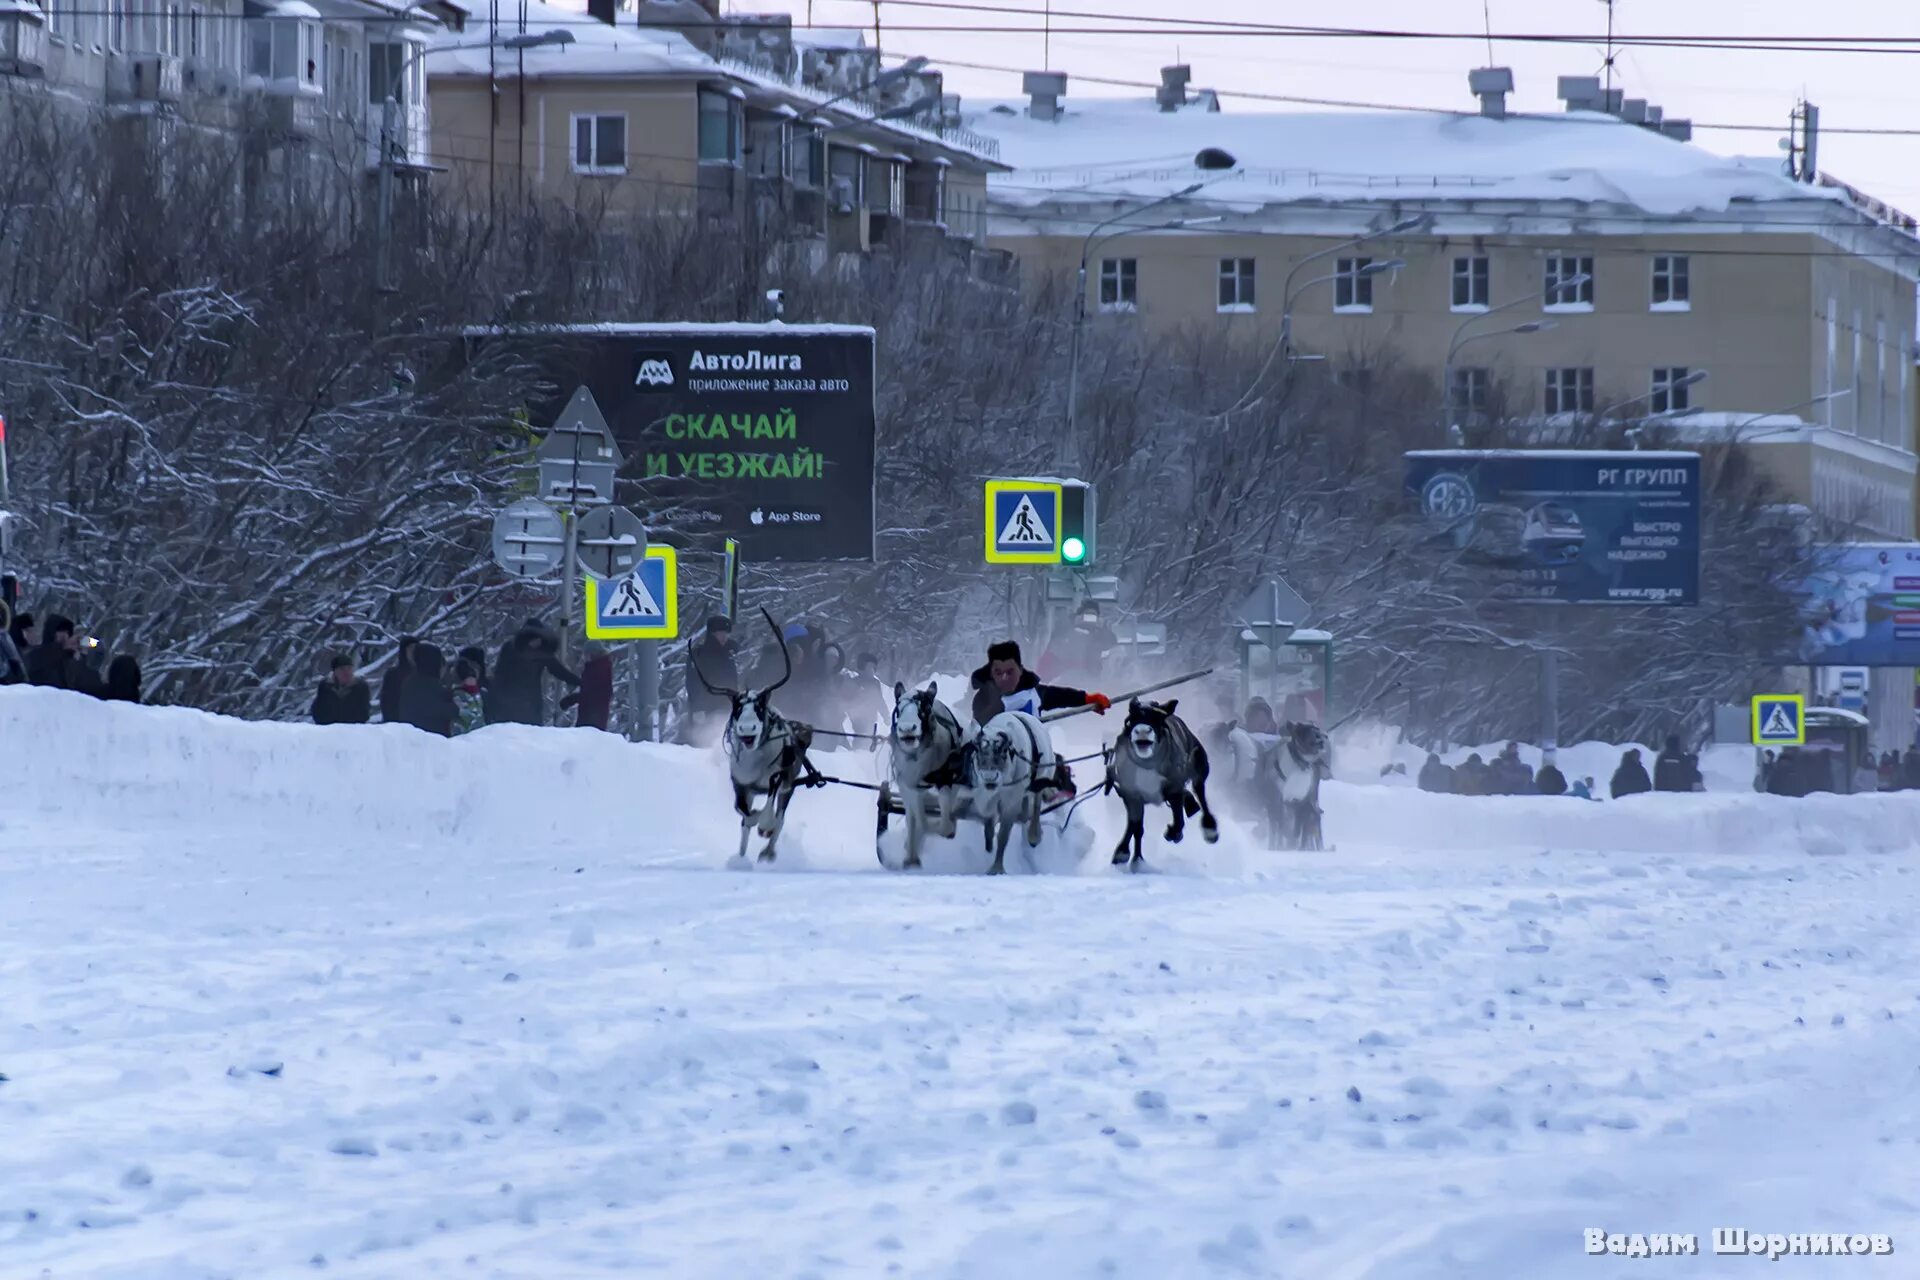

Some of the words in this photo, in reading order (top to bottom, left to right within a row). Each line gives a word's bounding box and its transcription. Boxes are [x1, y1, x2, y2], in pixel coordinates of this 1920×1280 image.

[689, 350, 802, 370] АвтоЛига
[688, 378, 770, 394] приложение
[773, 378, 816, 391] заказа
[820, 378, 850, 391] авто
[665, 407, 797, 440] СКАЧАЙ
[645, 453, 668, 478] И
[677, 447, 823, 479] УЕЗЖАЙ!
[1597, 469, 1619, 484] РГ
[1624, 468, 1687, 485] ГРУПП
[768, 510, 789, 522] App
[792, 510, 822, 522] Store
